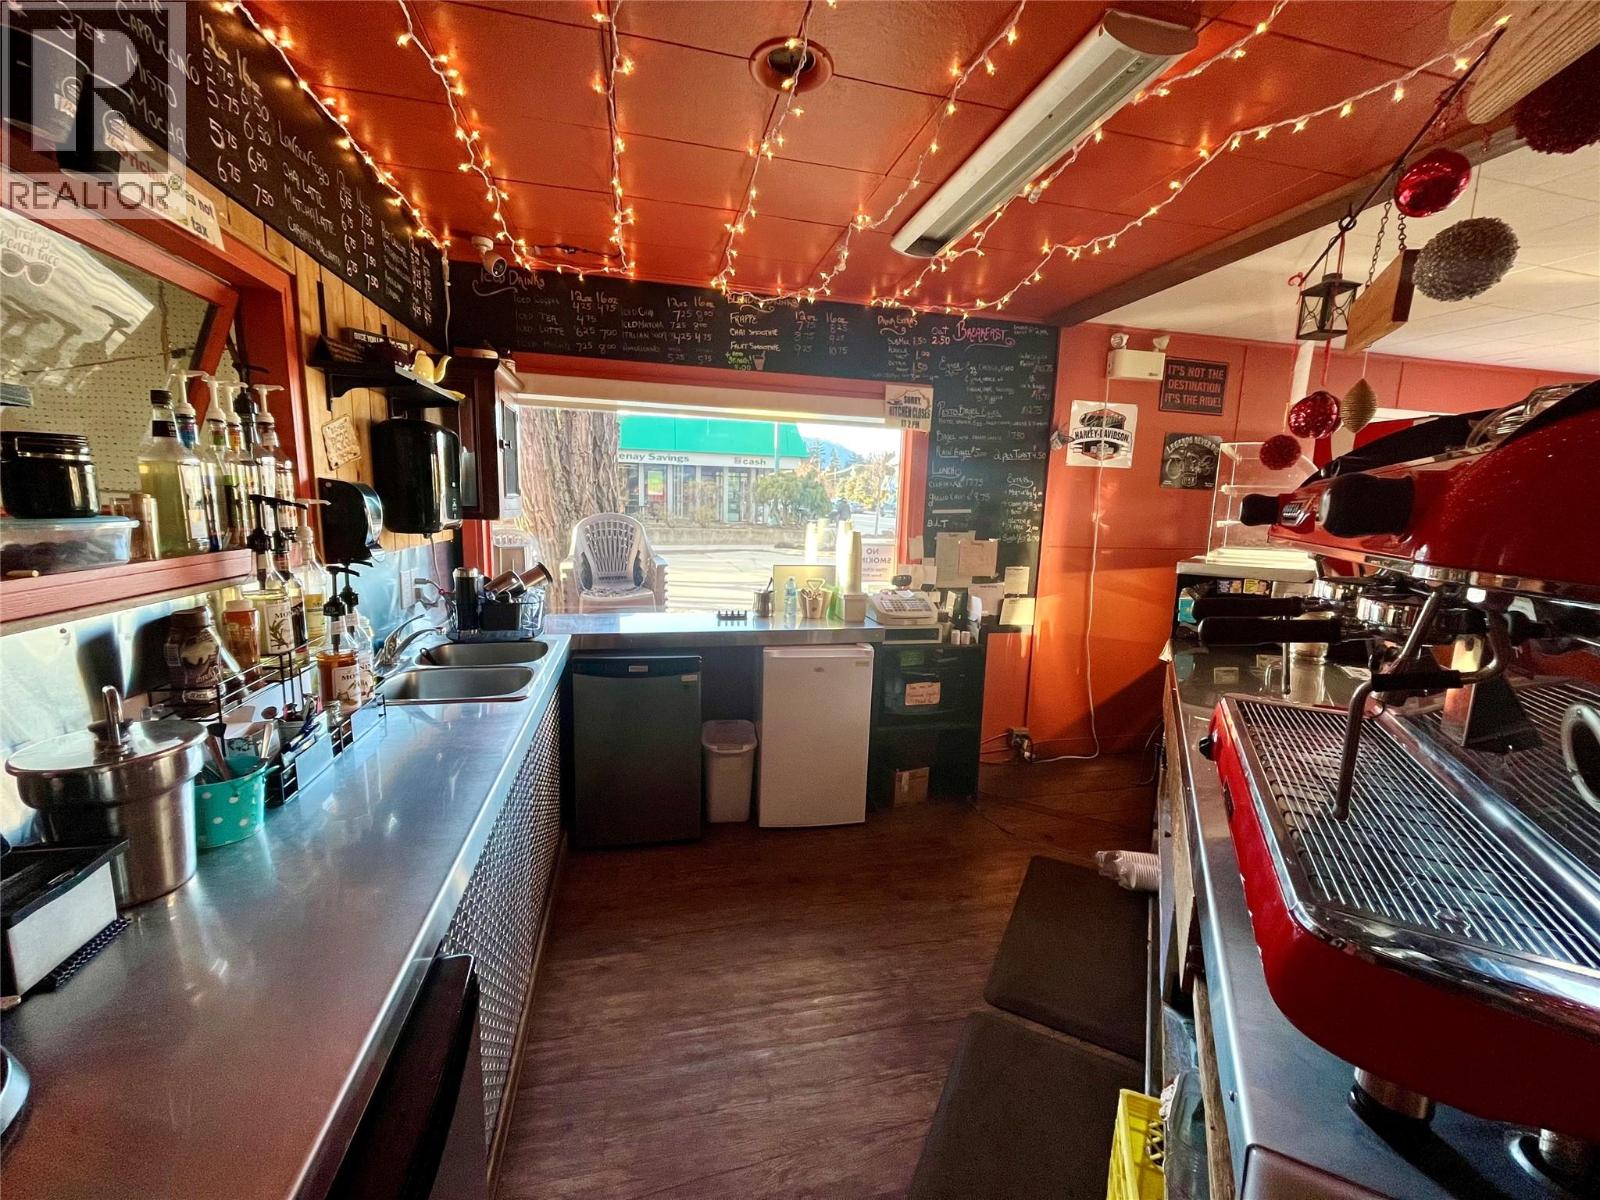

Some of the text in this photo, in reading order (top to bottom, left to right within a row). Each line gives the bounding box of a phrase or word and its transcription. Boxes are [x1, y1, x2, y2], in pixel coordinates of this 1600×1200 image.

[1167, 364, 1225, 380] IT'S NOT THE
[1168, 378, 1222, 393] DESTINATION
[1164, 392, 1180, 404] IT'S
[1182, 394, 1199, 406] THE
[618, 453, 644, 463] enay
[647, 453, 690, 464] Savings
